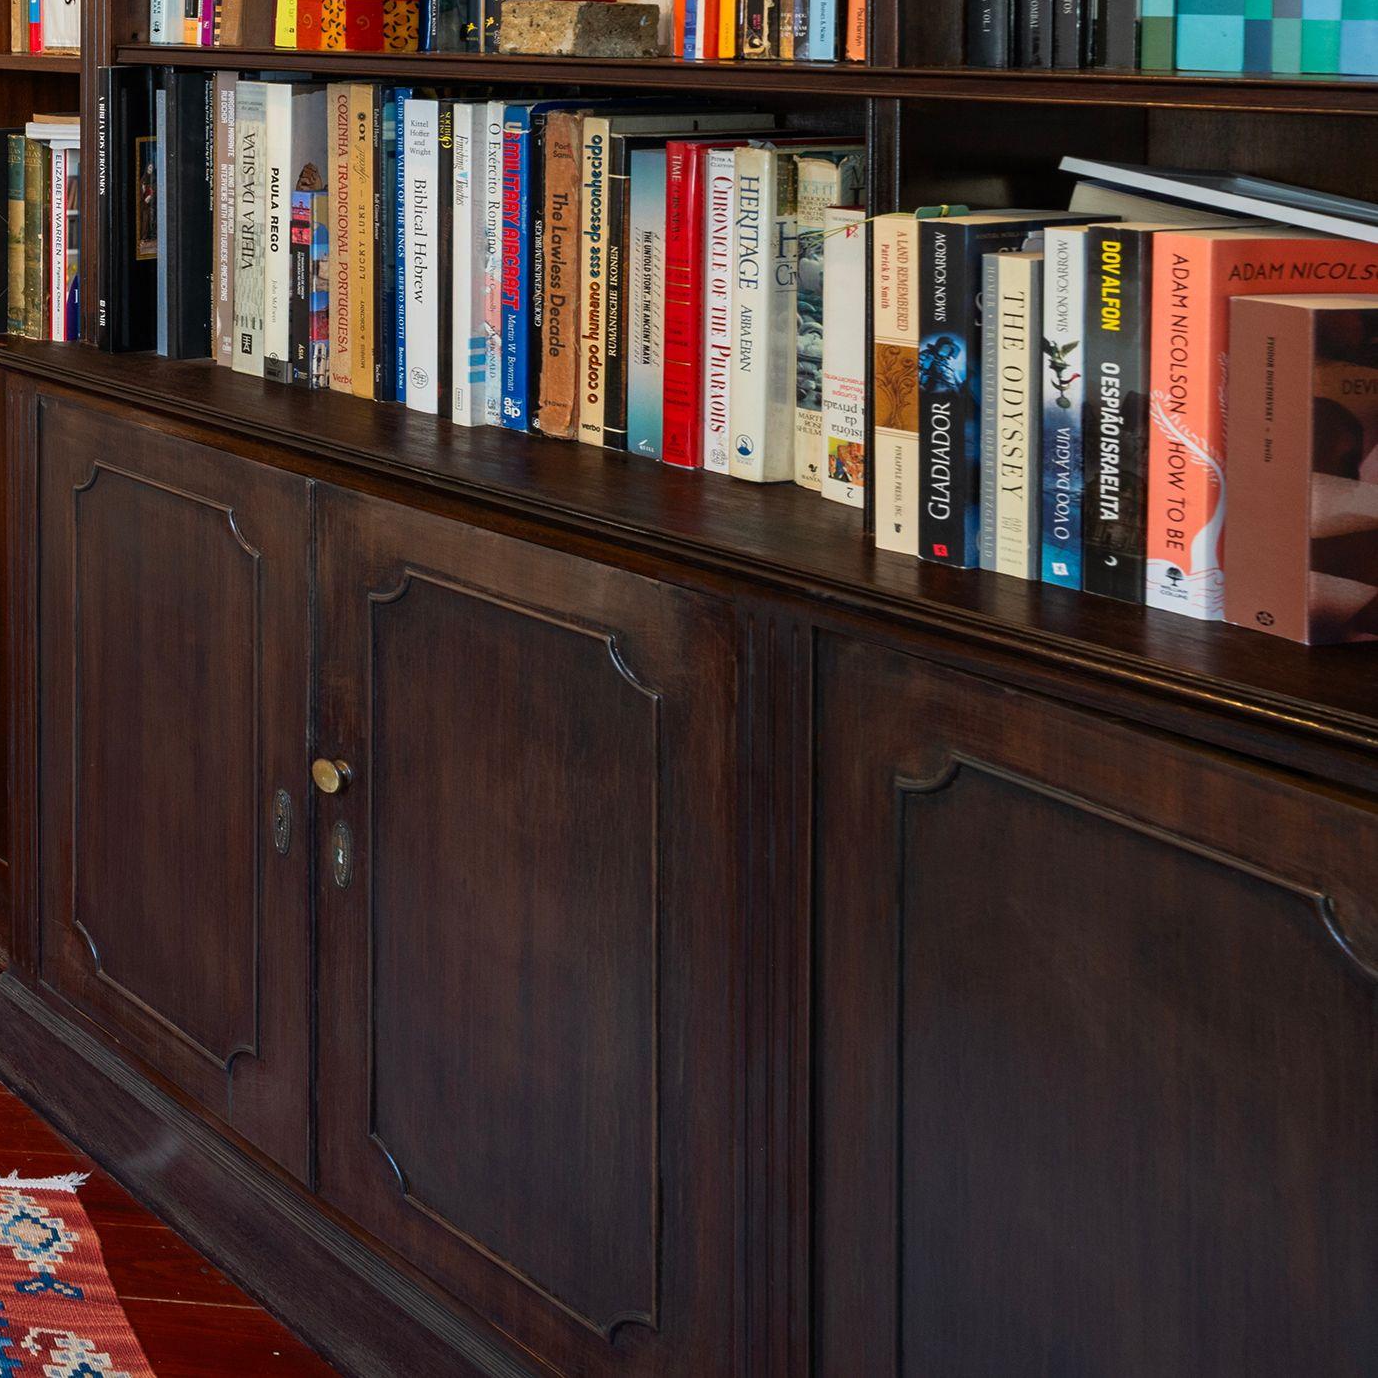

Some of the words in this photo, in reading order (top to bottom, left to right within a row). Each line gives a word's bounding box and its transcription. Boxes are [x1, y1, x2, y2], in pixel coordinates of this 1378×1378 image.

[337, 93, 348, 158] COZINHA
[397, 95, 405, 121] GUIDE
[242, 132, 256, 177] SILVA
[397, 154, 405, 189] VALLEY
[409, 149, 432, 164] Wright
[487, 141, 502, 195] Exército
[269, 167, 279, 210] PAULA
[414, 179, 428, 232] Biblical
[503, 142, 522, 224] MILITARY
[553, 192, 569, 220] The
[584, 134, 603, 244] desconhecido
[269, 215, 278, 254] REGO
[337, 162, 349, 257] TRADICIONAL
[486, 200, 501, 255] Romano
[710, 176, 735, 273] CHRONICLE
[738, 175, 760, 291] HERITAGE
[241, 208, 256, 271] VIEIRA
[397, 226, 405, 258] KINGS
[550, 222, 567, 288] Lawless
[589, 246, 601, 280] esse
[608, 245, 619, 285] IKONEN
[881, 244, 890, 273] Patrick
[896, 239, 907, 264] LAND
[935, 231, 947, 295] SCARROW
[1101, 241, 1122, 277] DOV
[414, 235, 428, 304] Hebrew
[501, 225, 522, 312] AIRCRAFT
[711, 278, 726, 300] OF
[1057, 239, 1070, 301] SCARROW
[1171, 253, 1190, 309] ADAM
[1229, 262, 1284, 282] ADAM
[337, 261, 349, 355] PORTUGUESA
[583, 282, 600, 340] humano
[608, 286, 618, 358] RUMÄNISCHE
[711, 304, 726, 336] THE
[739, 304, 752, 339] ABBA
[897, 265, 909, 333] REMEMBERED
[935, 295, 947, 324] SIMON
[1003, 291, 1025, 352] THE
[1057, 302, 1070, 333] SIMON
[1101, 277, 1121, 332] ALFON
[548, 291, 566, 359] Decade
[506, 358, 518, 393] Bowman
[583, 341, 599, 390] corpo
[738, 338, 752, 374] EBAN
[1167, 314, 1188, 414] NICOLSON
[709, 342, 732, 435] PHARAOHS
[1100, 374, 1120, 441] ESPIÃO
[581, 422, 602, 434] verbo
[1001, 364, 1025, 501] ODYSSEY
[1054, 426, 1071, 469] ÁGUIA
[927, 402, 951, 520] GLADIADOR
[1054, 470, 1070, 492] DA
[1099, 440, 1120, 521] ISRAELITA
[1167, 443, 1188, 491] HOW
[1054, 492, 1070, 525] VOO
[1166, 497, 1187, 523] TO
[1165, 525, 1187, 552] BE
